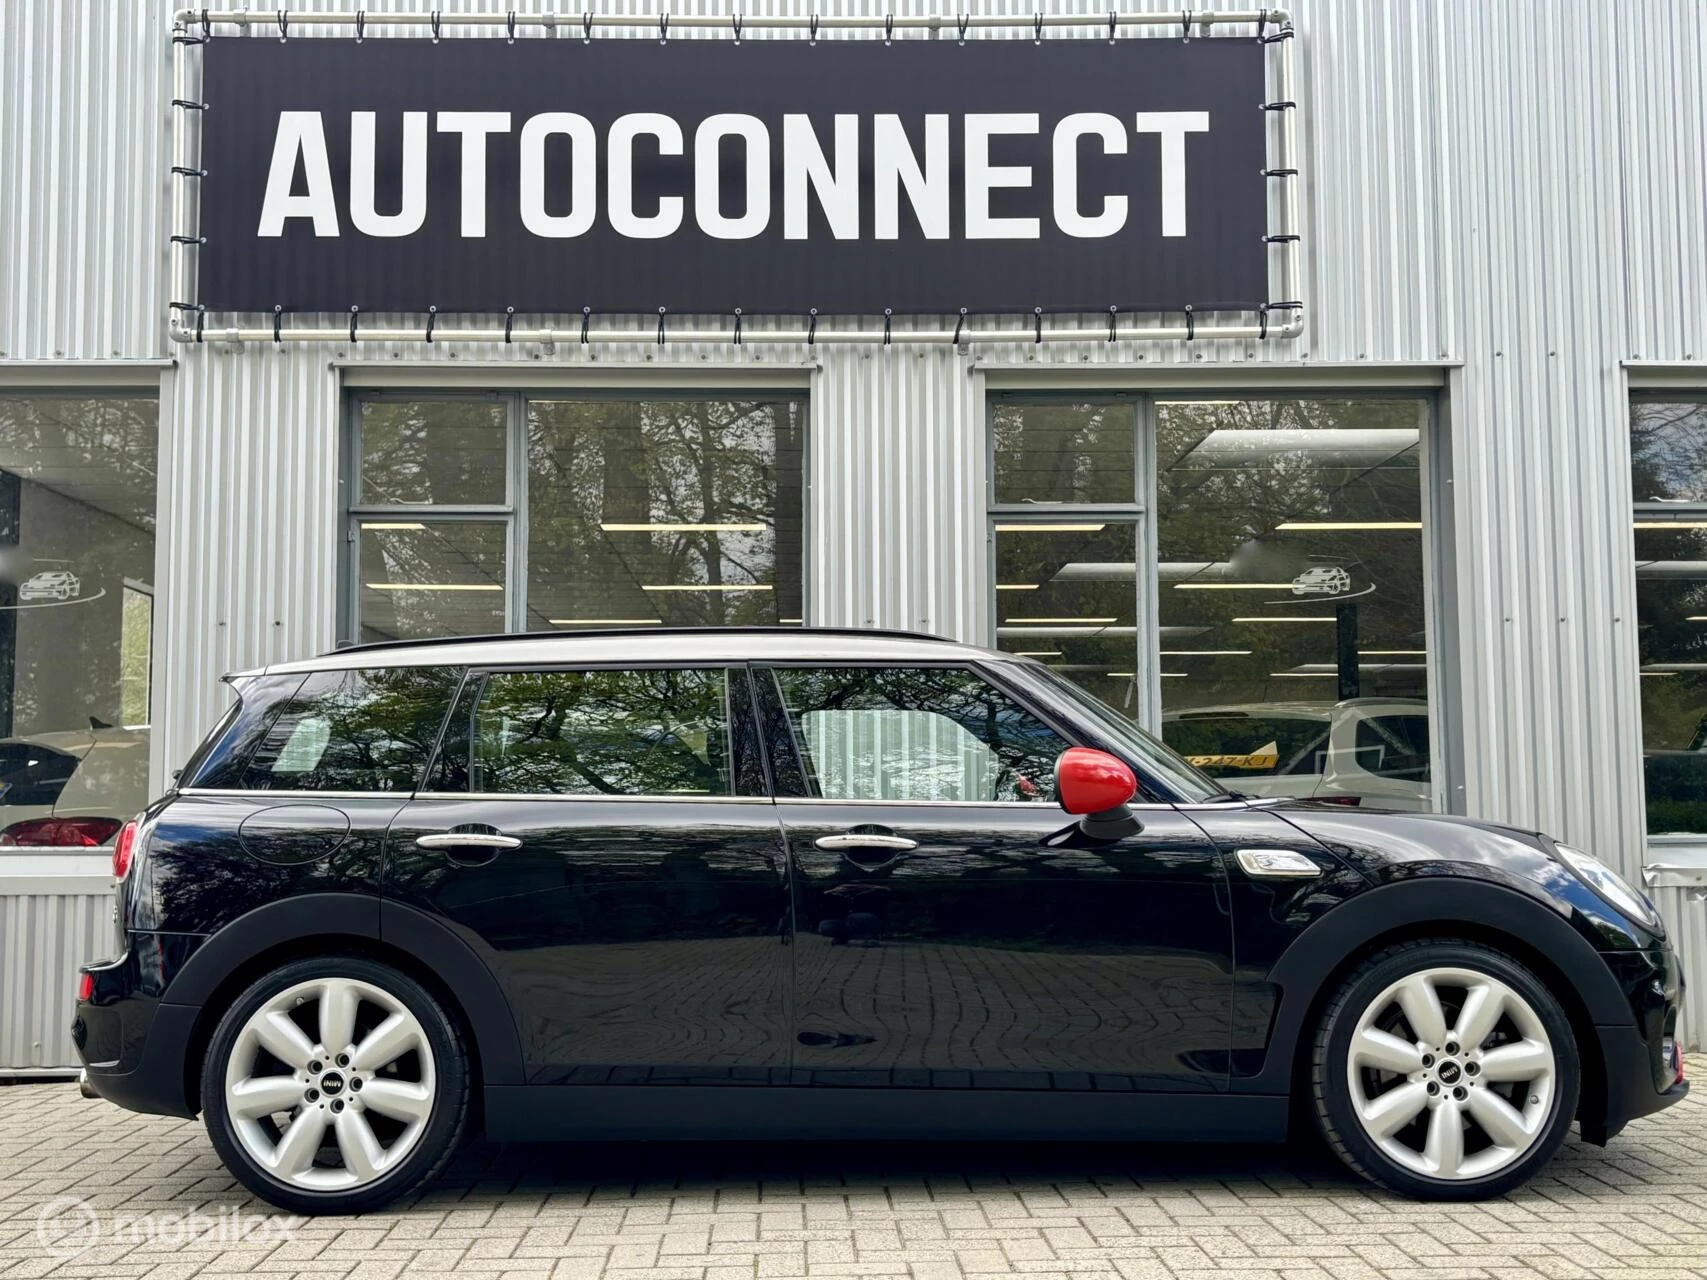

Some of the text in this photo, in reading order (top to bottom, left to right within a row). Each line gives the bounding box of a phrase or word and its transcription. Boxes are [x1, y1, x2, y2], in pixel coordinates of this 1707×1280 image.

[257, 110, 1210, 241] AUTOCONNECT
[1441, 1066, 1458, 1079] MINI
[323, 1079, 341, 1087] MINI
